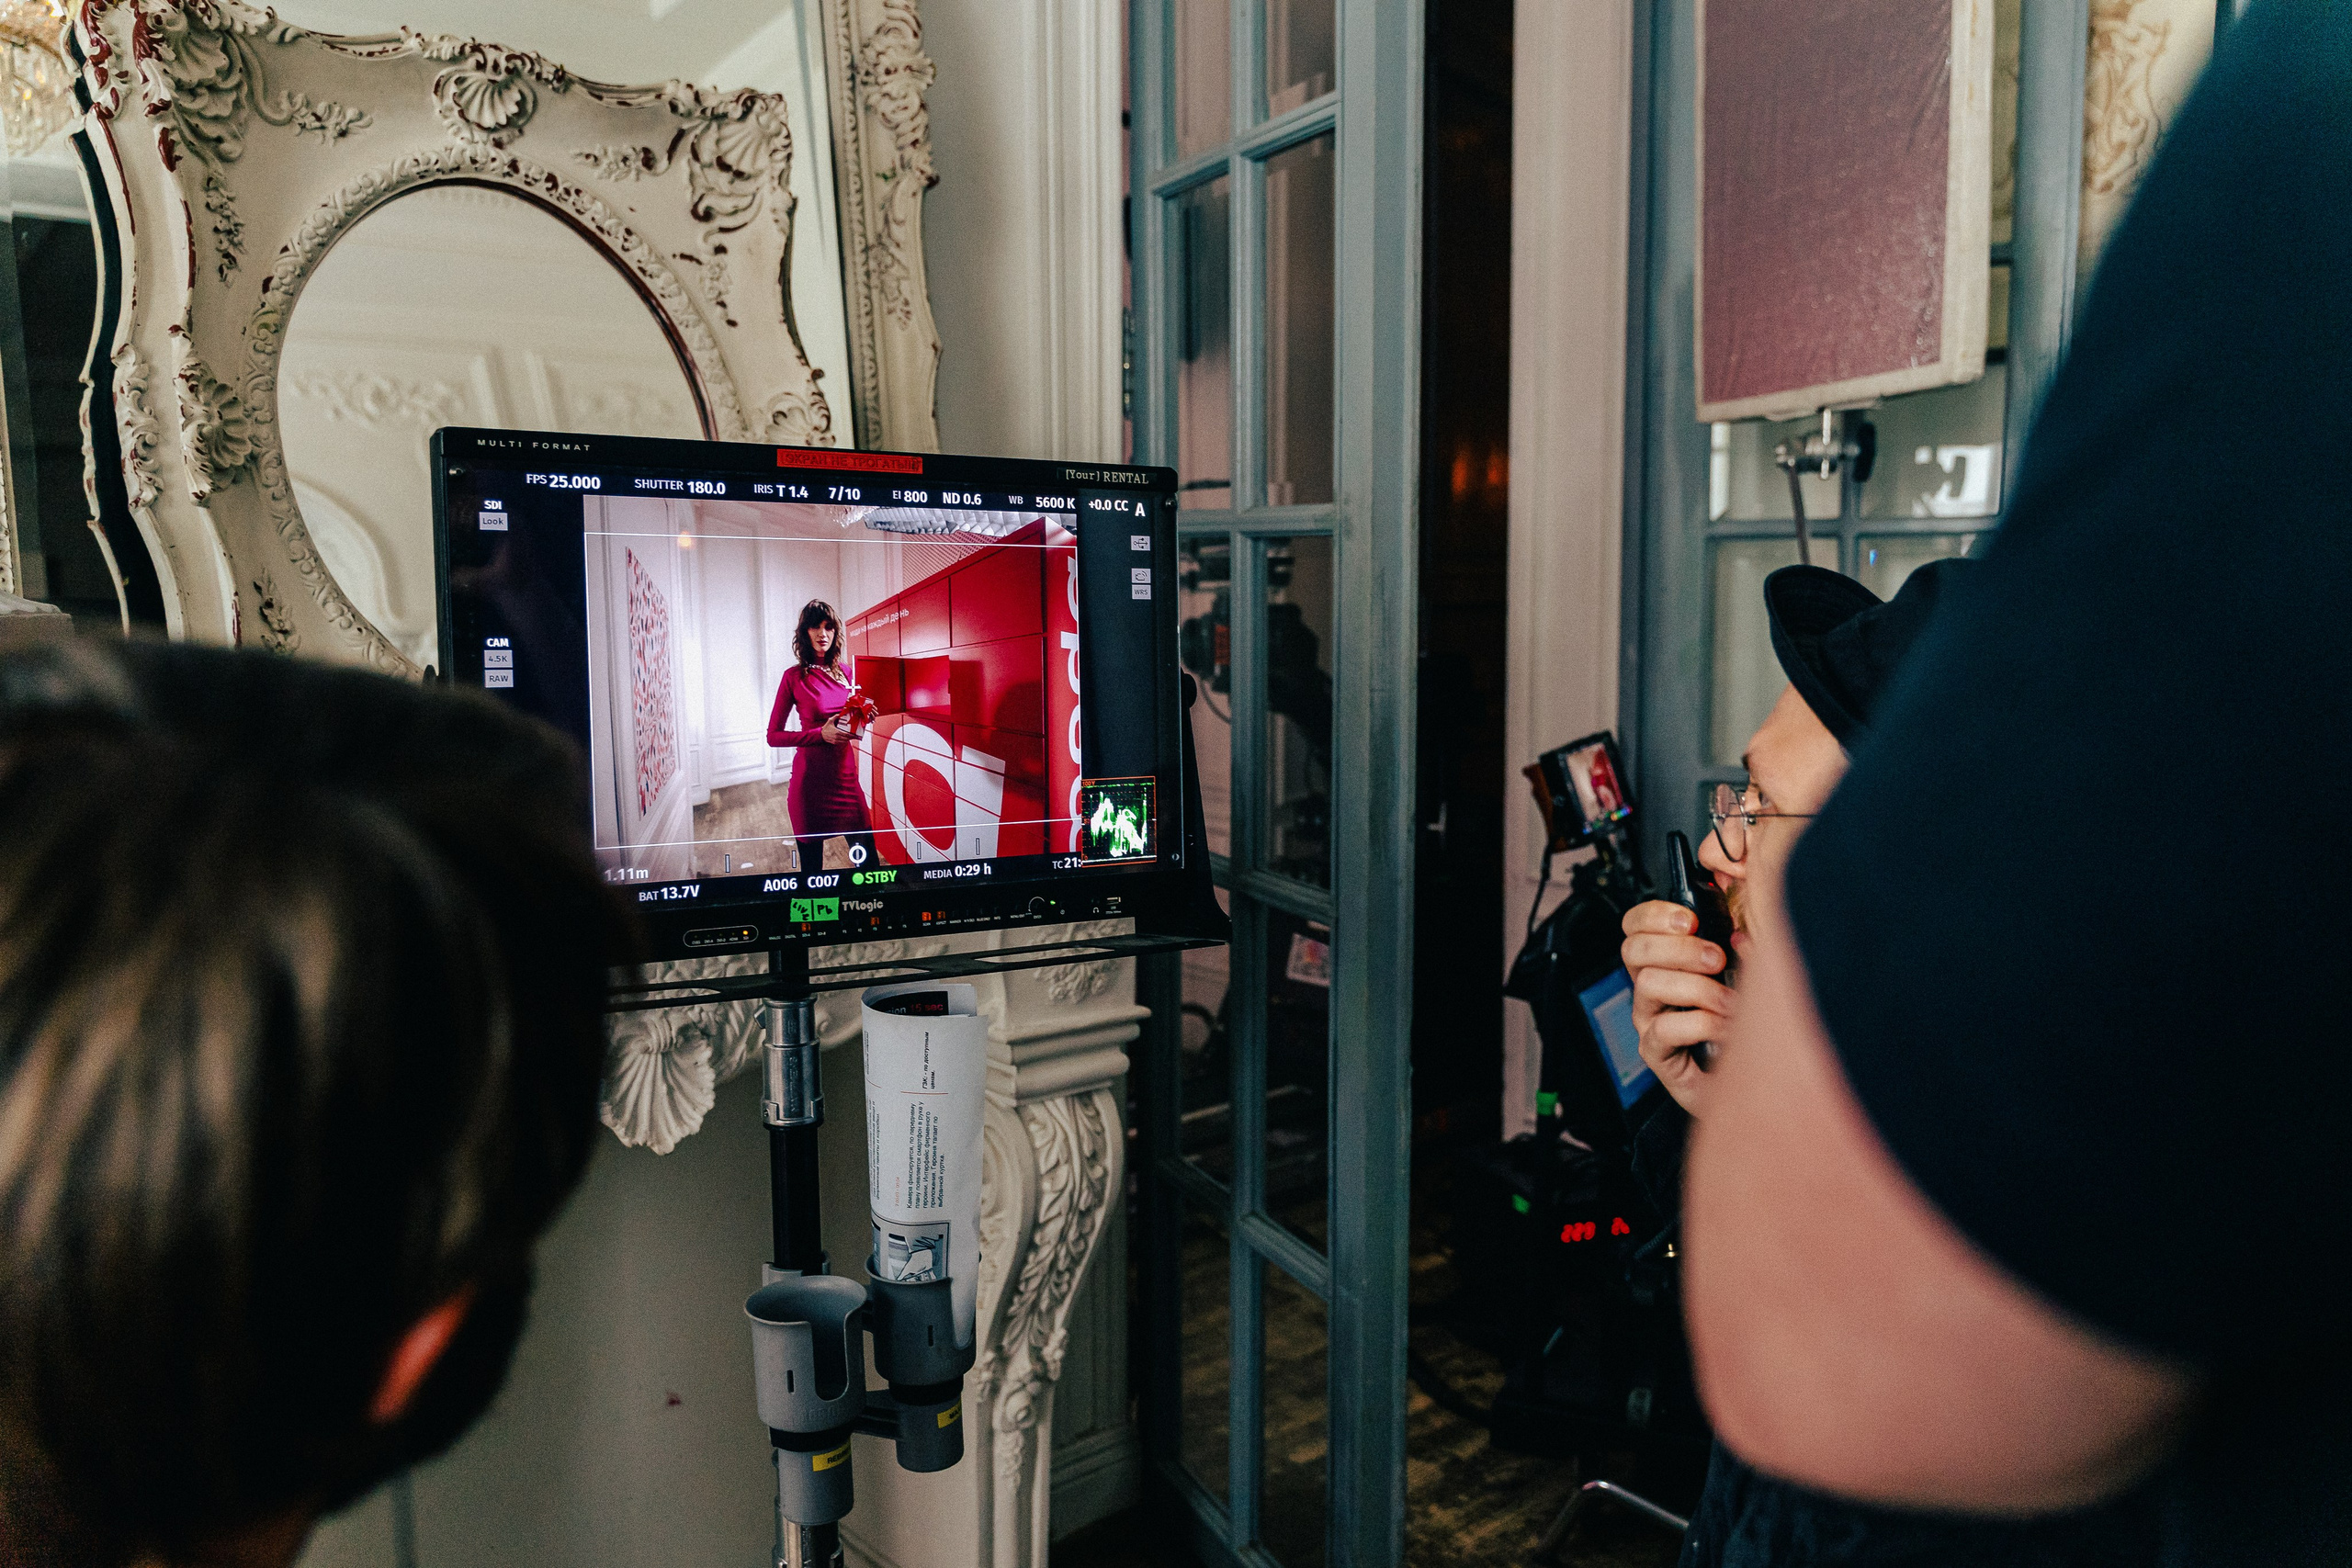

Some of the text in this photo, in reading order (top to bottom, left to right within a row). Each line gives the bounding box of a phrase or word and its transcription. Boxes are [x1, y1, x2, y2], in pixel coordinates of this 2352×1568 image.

[478, 439, 591, 452] MULTI FORMAT
[526, 473, 602, 490] FPS 25.000
[1103, 471, 1149, 484] RENTAL
[634, 478, 726, 496] SHUTTER 180.0
[753, 484, 809, 499] IRIS T 1.4
[828, 486, 861, 502] 7/10
[892, 490, 928, 504] EI 800
[943, 491, 982, 506] ND 0.6
[1009, 494, 1076, 510] WB 5600 K
[483, 500, 503, 511] SDI
[1088, 499, 1129, 512] +0.0 CC
[1135, 502, 1147, 517] A
[482, 516, 504, 526] Look
[1134, 588, 1148, 596] WRS
[889, 608, 910, 624] день
[486, 637, 510, 648] CAM
[923, 863, 991, 880] MEDIA 0:29 h
[1052, 861, 1063, 869] TC
[763, 874, 840, 893] A006 C007
[865, 870, 898, 884] STBY
[639, 885, 700, 901] BAT 13.7V
[842, 898, 884, 912] TVlogic
